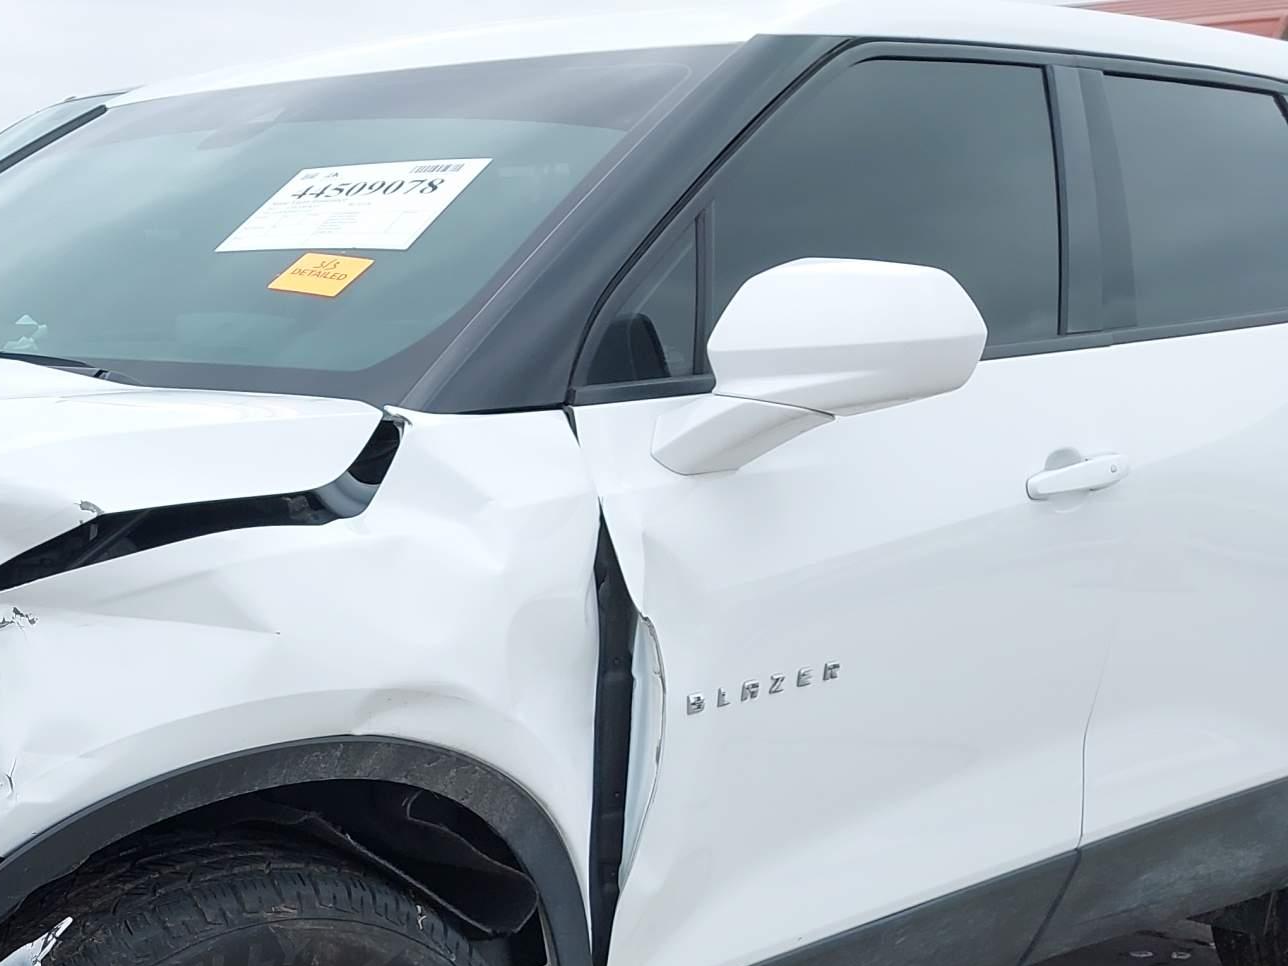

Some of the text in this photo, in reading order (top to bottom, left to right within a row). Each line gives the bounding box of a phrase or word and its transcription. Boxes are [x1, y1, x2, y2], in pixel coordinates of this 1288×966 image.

[291, 177, 445, 200] 44509078
[290, 268, 348, 281] DETAILED
[686, 661, 841, 716] BLAZER
